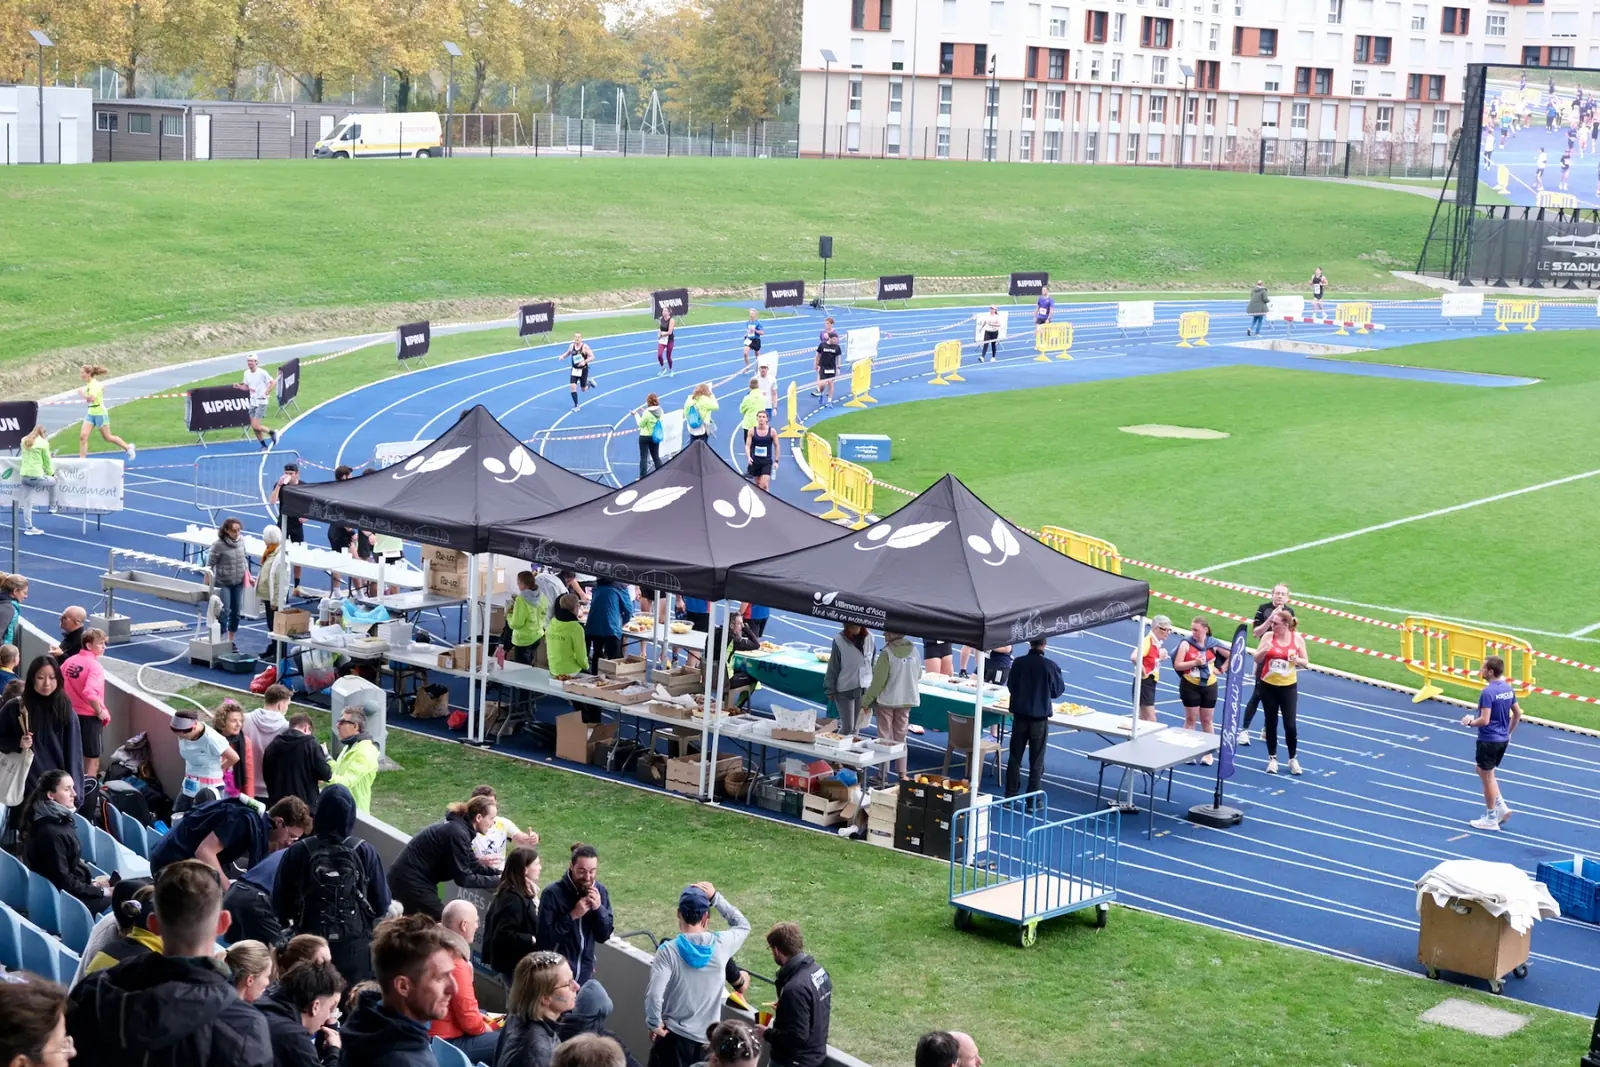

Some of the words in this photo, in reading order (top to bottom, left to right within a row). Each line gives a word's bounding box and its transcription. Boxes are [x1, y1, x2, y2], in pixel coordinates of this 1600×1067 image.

[1537, 261, 1550, 270] LE
[884, 283, 907, 292] KIPRUN
[1017, 279, 1042, 287] KIPRUN
[771, 289, 798, 298] KIPRUN
[658, 298, 683, 309] KIPRUN
[525, 313, 548, 324] KIPRUN
[202, 398, 250, 414] KIPRUN
[835, 600, 864, 613] Villeneuve
[865, 606, 887, 618] d'Ascq
[811, 606, 826, 617] Une
[826, 610, 838, 620] ville
[848, 616, 885, 628] mouvement
[457, 888, 485, 910] ACCÈS
